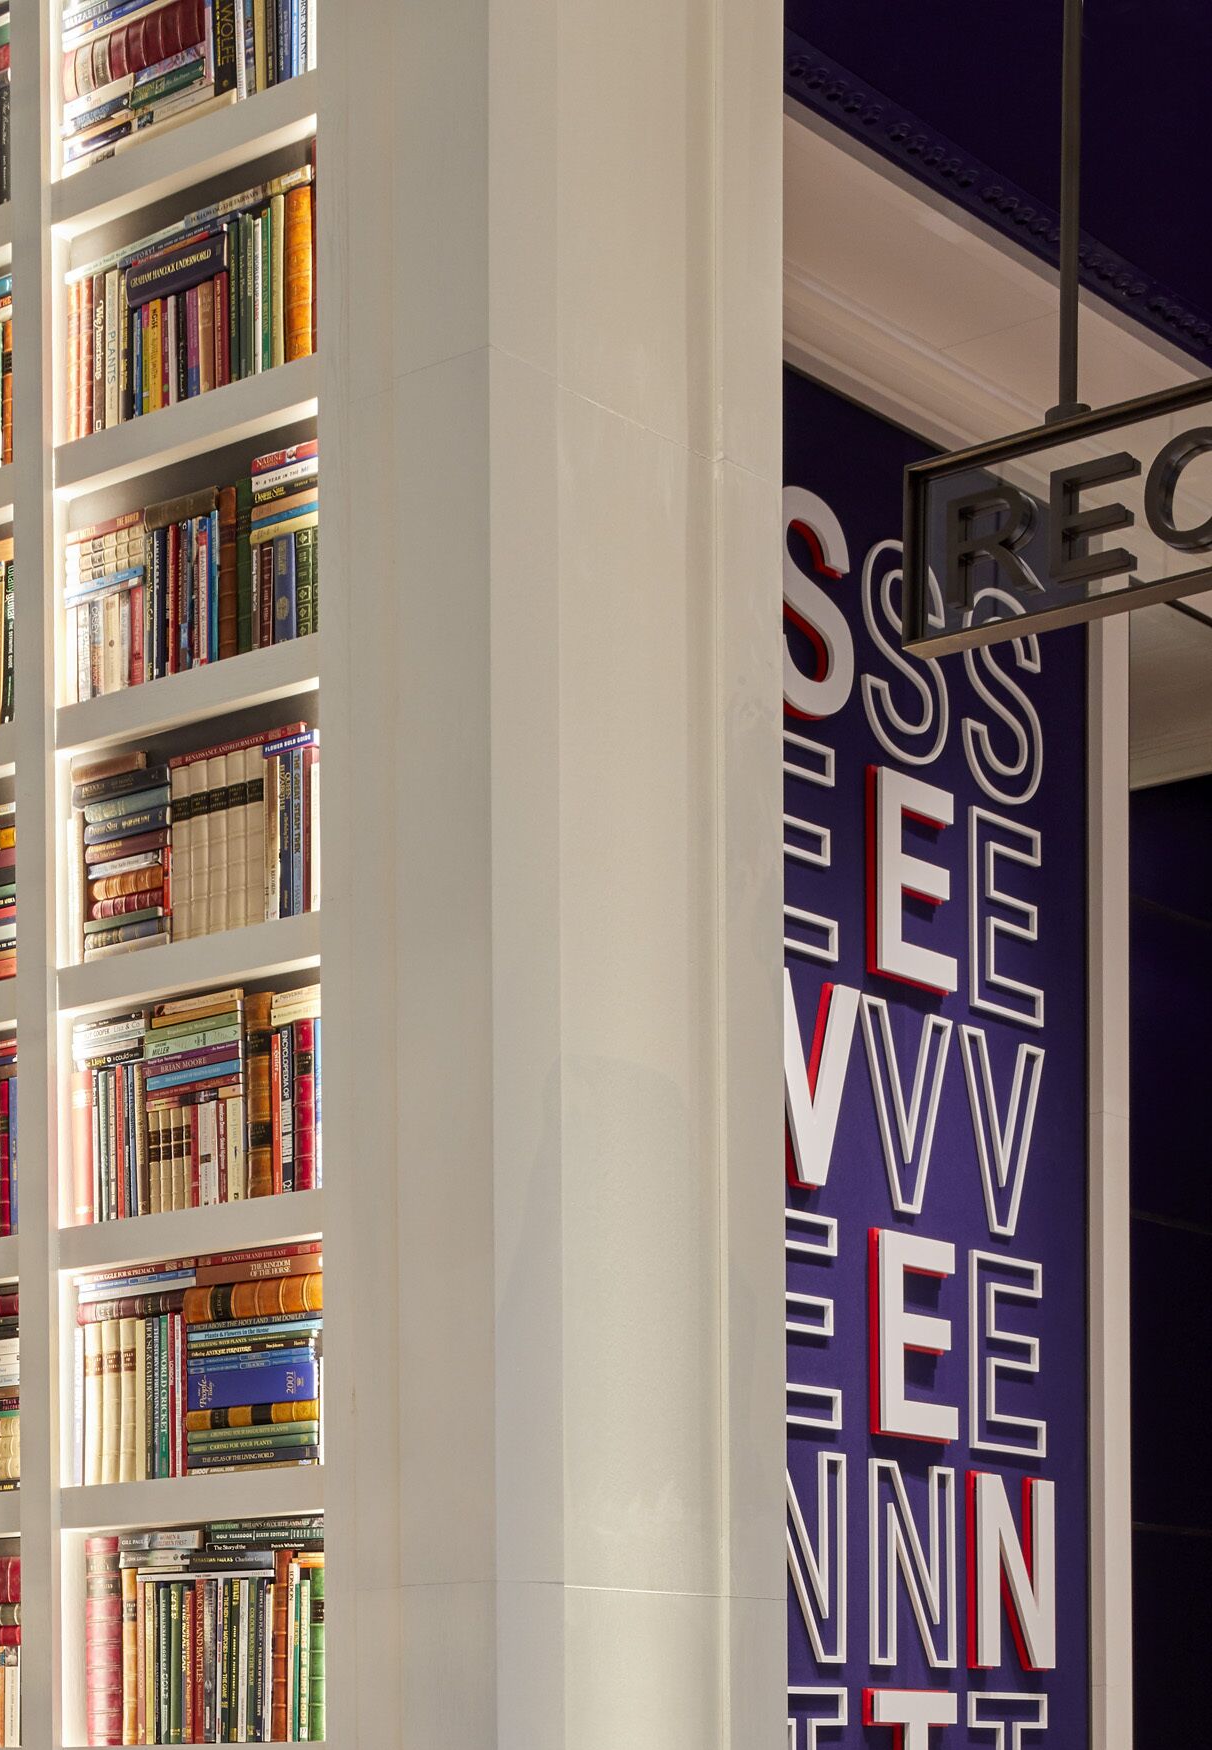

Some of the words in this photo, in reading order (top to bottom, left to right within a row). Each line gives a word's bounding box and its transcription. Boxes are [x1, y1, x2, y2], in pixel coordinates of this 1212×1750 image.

[107, 330, 117, 385] PLANTS
[160, 1062, 181, 1073] BRIAN
[182, 1056, 207, 1068] MOORE
[251, 1262, 263, 1270] THE
[263, 1259, 291, 1268] KINGDOM
[260, 1268, 271, 1276] THE
[253, 1316, 268, 1324] LAND
[160, 1388, 168, 1434] CRICKET
